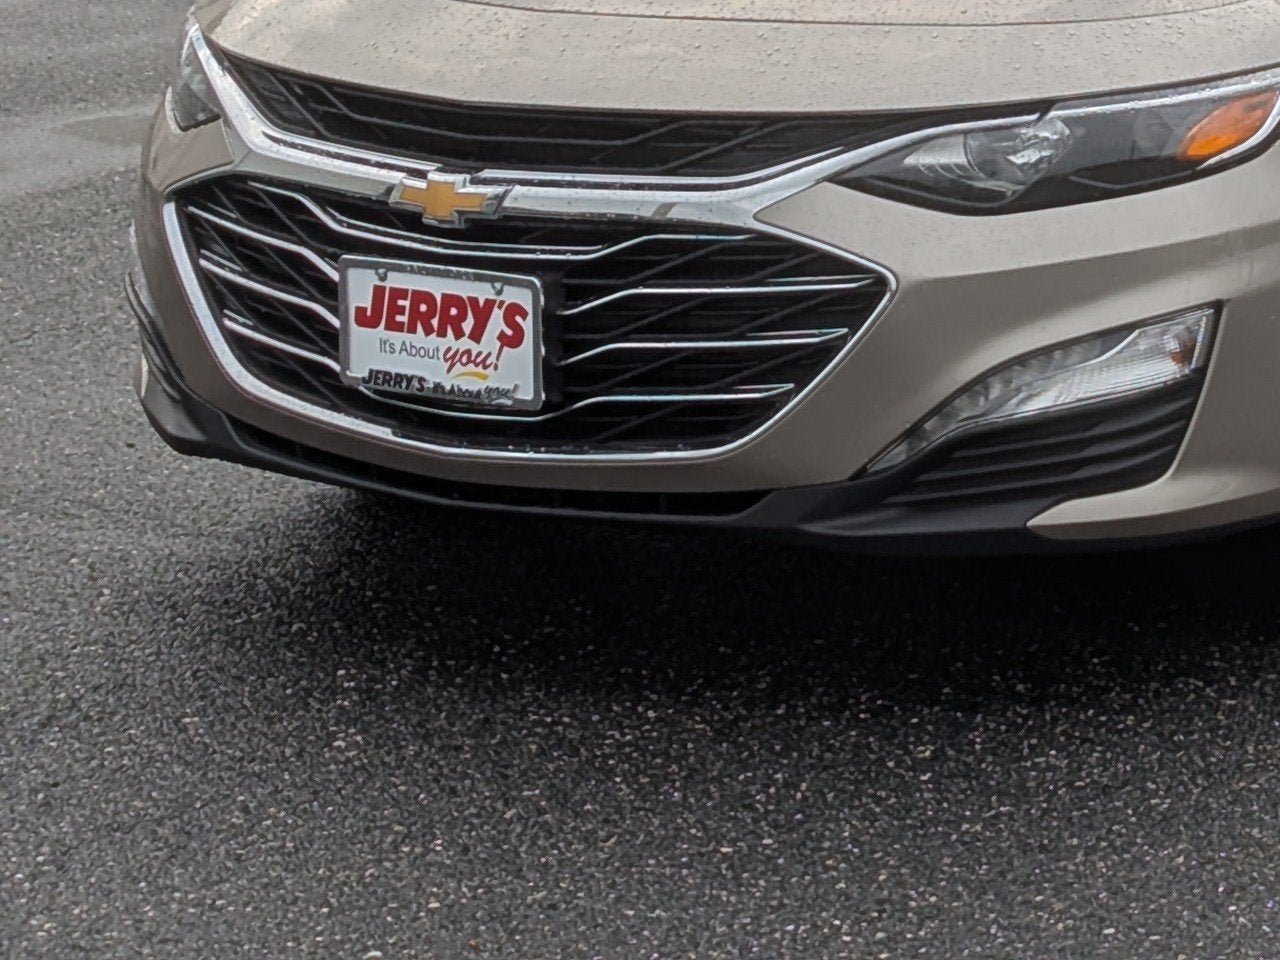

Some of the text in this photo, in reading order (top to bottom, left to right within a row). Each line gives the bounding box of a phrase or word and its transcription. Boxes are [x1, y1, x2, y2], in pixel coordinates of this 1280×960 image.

[354, 284, 529, 349] JERRY'S
[379, 338, 506, 375] It's About you!
[361, 368, 428, 393] JERRY'S
